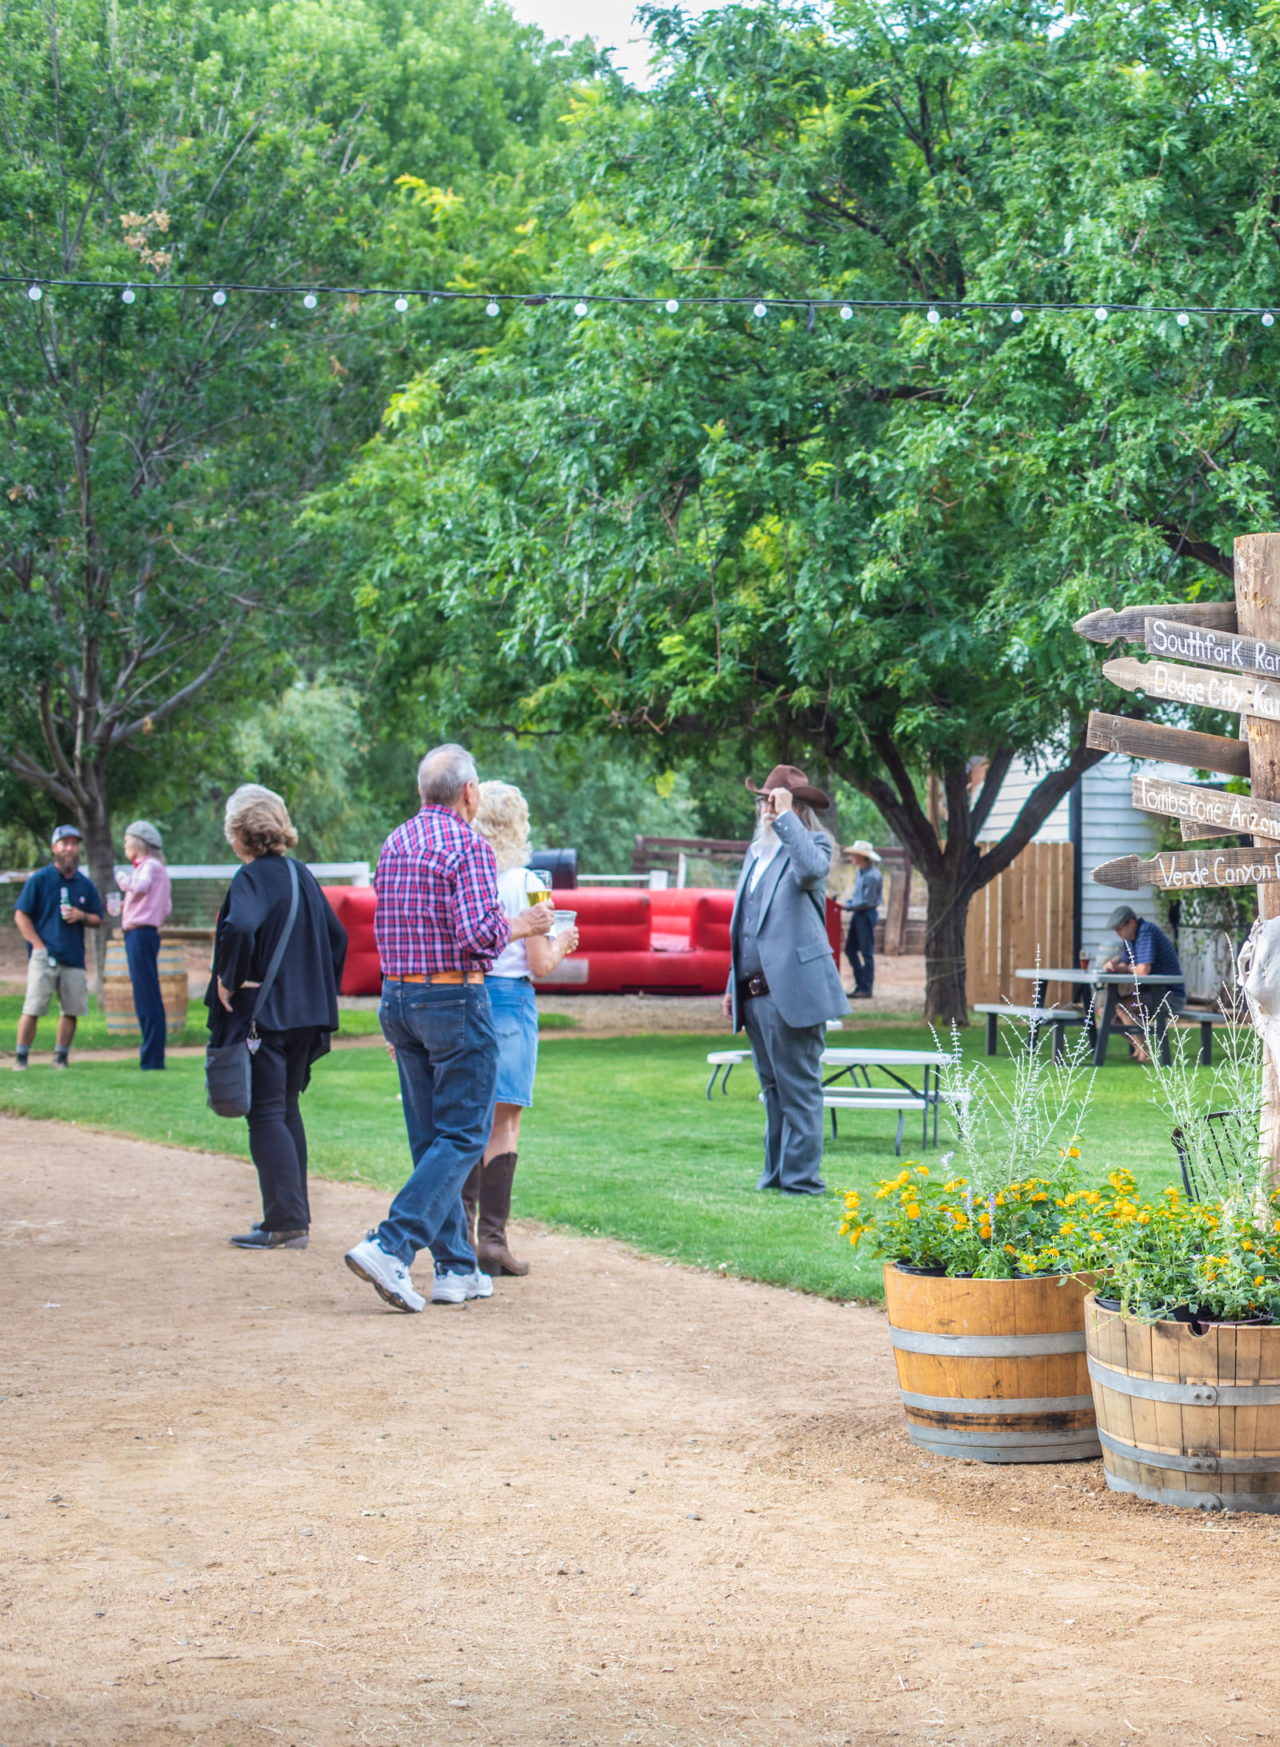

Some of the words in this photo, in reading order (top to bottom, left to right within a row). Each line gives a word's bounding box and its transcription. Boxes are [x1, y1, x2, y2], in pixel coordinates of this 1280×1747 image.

[1154, 665, 1205, 703] Dodge
[1207, 676, 1246, 712] City
[1136, 777, 1223, 823] Tombstone
[1158, 854, 1210, 888] Verde
[1213, 856, 1272, 885] Canyon
